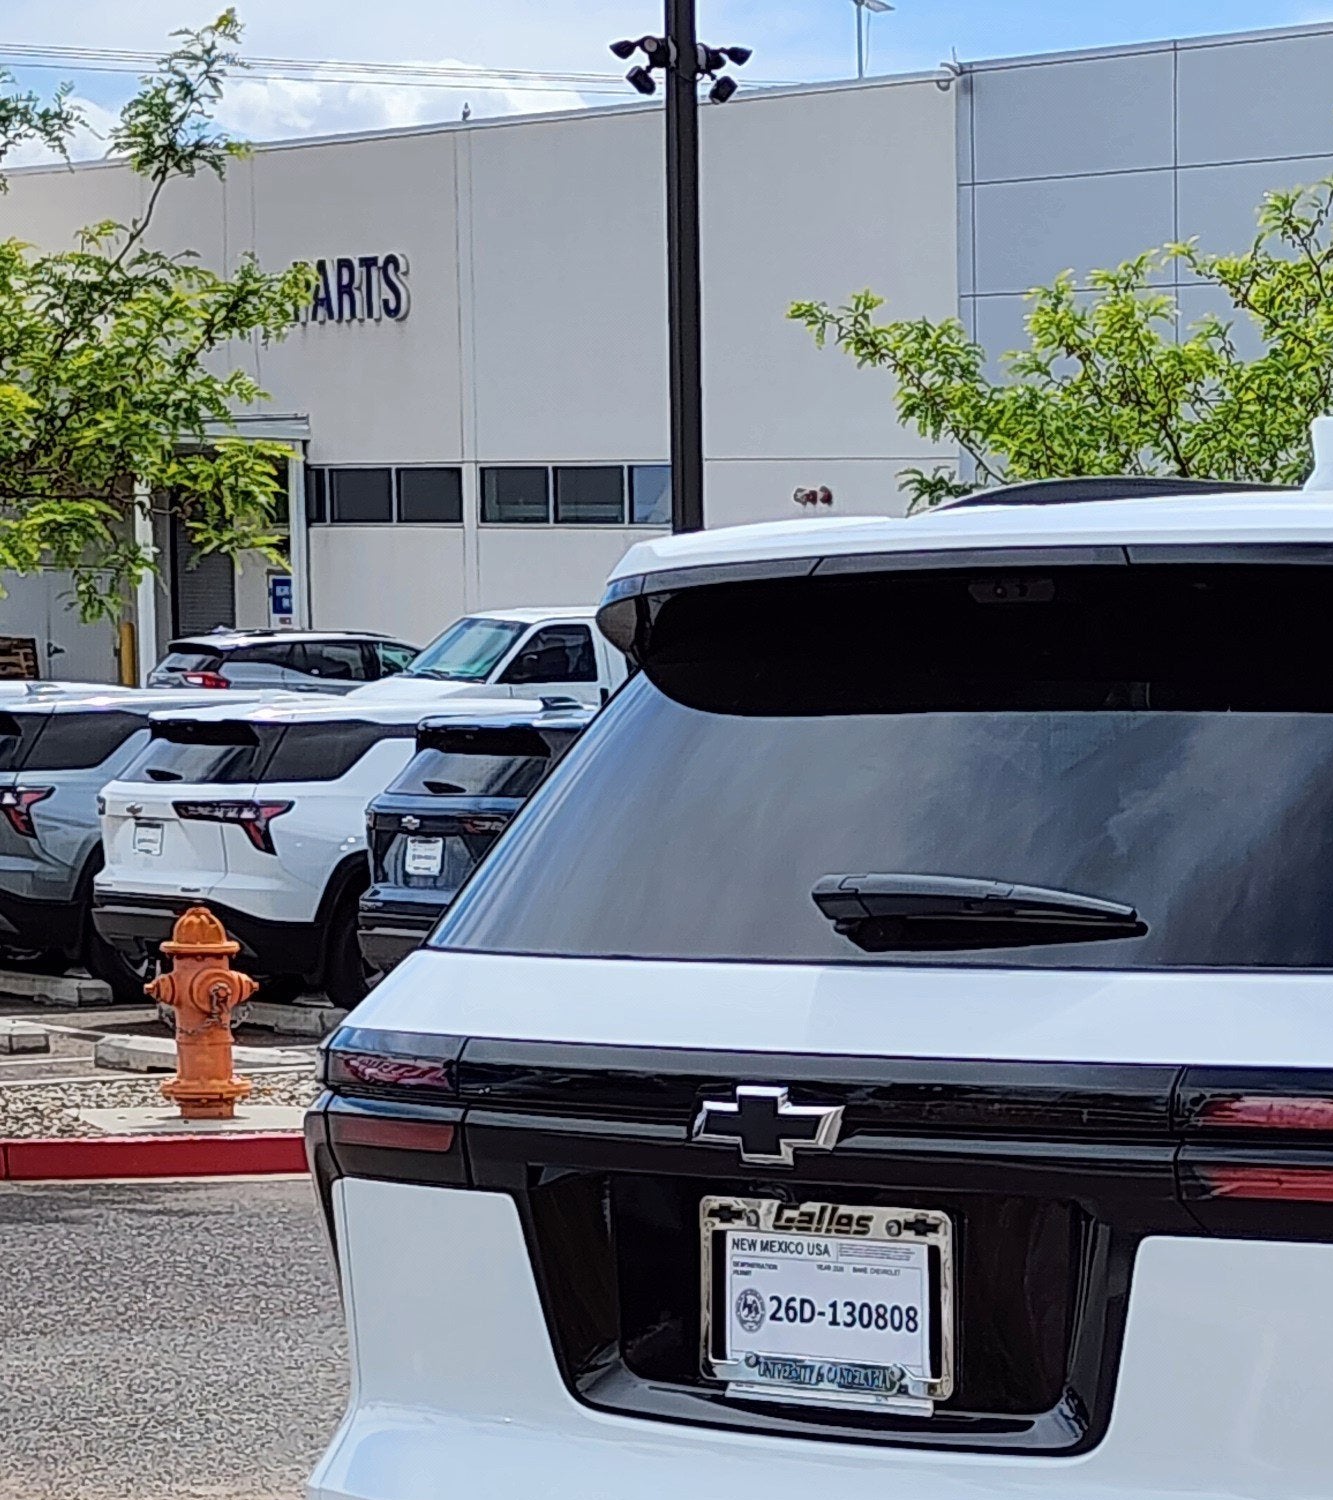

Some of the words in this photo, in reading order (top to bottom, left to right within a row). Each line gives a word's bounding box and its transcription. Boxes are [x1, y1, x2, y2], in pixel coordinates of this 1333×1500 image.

[292, 253, 401, 322] ARTS
[772, 1205, 874, 1236] Galles
[731, 1238, 757, 1252] NEW
[760, 1240, 804, 1256] MEXICO
[807, 1243, 831, 1258] USA
[768, 1295, 919, 1333] 26D-130808
